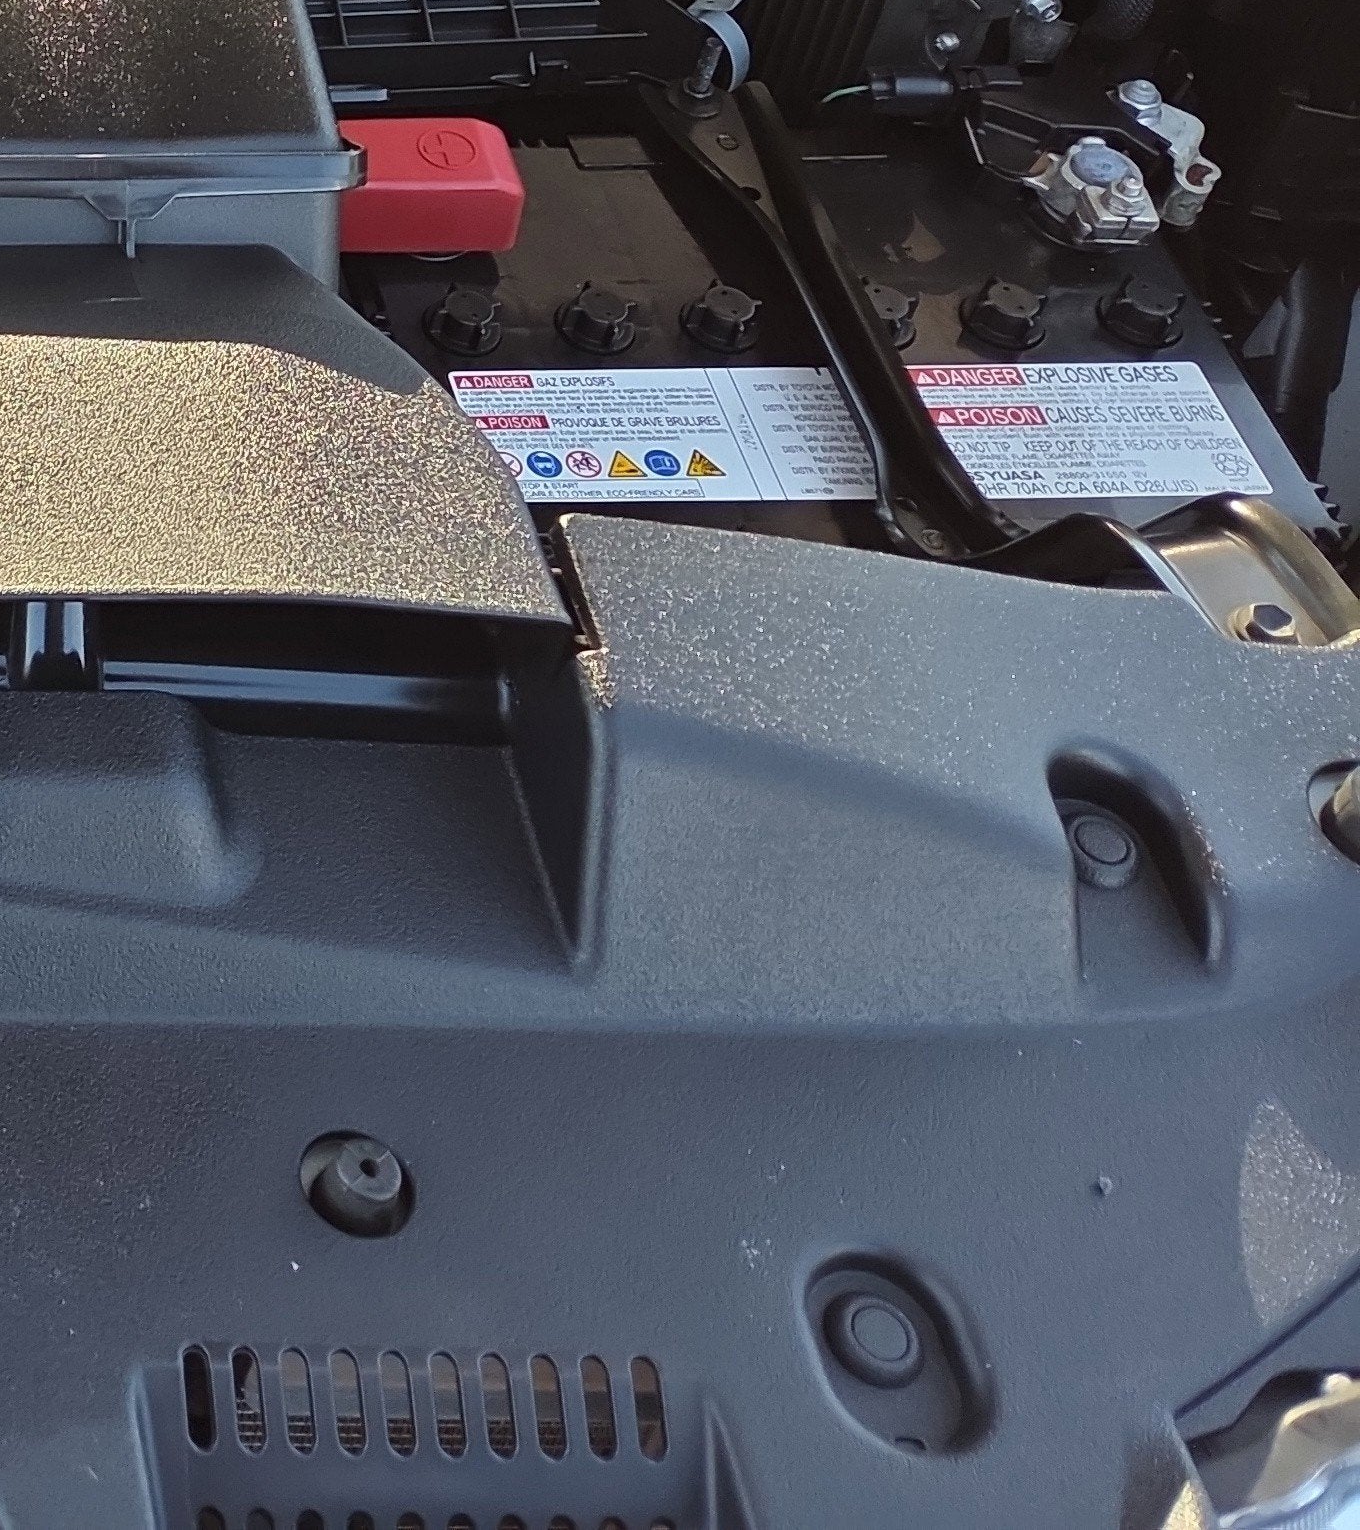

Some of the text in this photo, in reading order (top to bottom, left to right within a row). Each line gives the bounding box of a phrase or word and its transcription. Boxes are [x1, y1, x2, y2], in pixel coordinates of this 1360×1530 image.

[472, 375, 616, 388] DANGER GAZ EXPLOSIFS
[933, 365, 1179, 386] DANGER EXPLOSIVE GASES
[487, 415, 721, 429] POISON PROVOQUE DE GRAVE BRULURES
[954, 408, 1043, 425] POISON
[1044, 405, 1108, 424] CAUSES
[1108, 405, 1166, 423] SEVERE
[1168, 404, 1226, 422] BURNS
[967, 441, 992, 453] NOT
[992, 441, 1012, 453] TIP
[1023, 441, 1053, 453] KEEP
[1055, 440, 1080, 452] OUT
[1081, 440, 1097, 452] OF
[1098, 439, 1124, 451] THE
[1124, 438, 1165, 451] REACH
[1166, 438, 1183, 451] OF
[1183, 437, 1244, 451] CHILDREN
[986, 470, 1046, 481] YUASA
[1011, 482, 1054, 495] 70Ah
[1054, 481, 1091, 494] CCA
[1092, 480, 1133, 493] 604A
